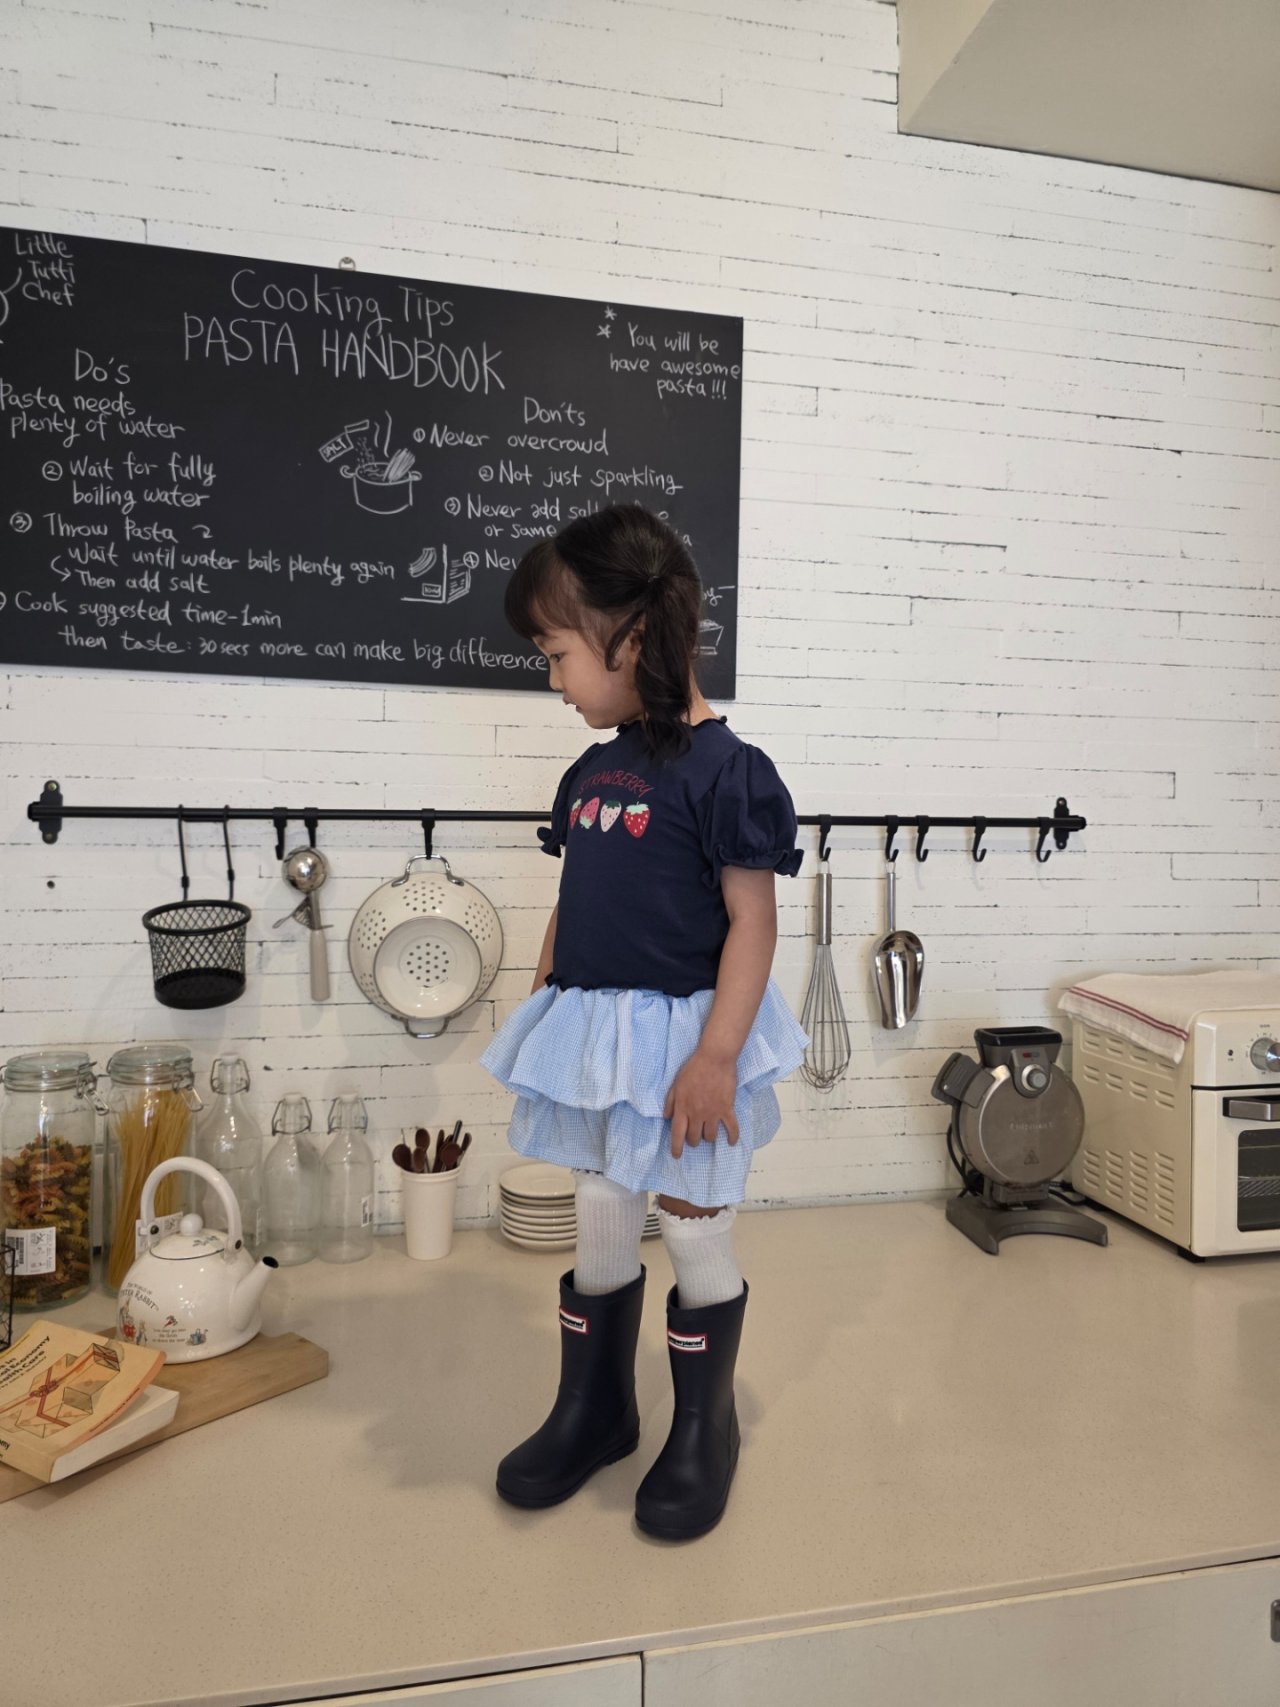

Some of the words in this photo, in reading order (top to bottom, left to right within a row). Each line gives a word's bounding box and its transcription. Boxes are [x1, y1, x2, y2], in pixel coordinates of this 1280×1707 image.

[15, 233, 74, 258] Little
[21, 280, 75, 307] Chef
[231, 269, 392, 339] Cooking
[398, 285, 454, 338] Tips
[184, 312, 299, 375] PASTA
[322, 329, 505, 394] HANDBOOK
[628, 322, 657, 351] You
[664, 331, 690, 352] will
[699, 333, 719, 355] be
[75, 348, 131, 385] Do's
[610, 353, 650, 372] have
[660, 358, 741, 380] awesome
[0, 378, 66, 413] Pasta
[73, 391, 136, 419] needs
[523, 396, 586, 427] Don'ts
[11, 411, 81, 448] plenty
[85, 414, 107, 441] of
[119, 416, 187, 439] water
[430, 423, 490, 448] Never
[507, 428, 609, 456] overcrowd
[69, 455, 114, 481] Wait
[122, 451, 159, 480] for
[168, 451, 217, 487] fully
[499, 459, 533, 486] Not
[542, 465, 582, 488] just
[591, 465, 684, 496] sparkling
[73, 480, 137, 515] boiling
[143, 484, 211, 507] water
[467, 493, 522, 519] Never
[531, 497, 560, 521] add
[42, 512, 108, 537] Throw
[124, 516, 179, 544] Pasta
[485, 524, 504, 537] or
[511, 523, 558, 539] same
[67, 541, 119, 567] Wait
[132, 546, 175, 570] until
[181, 549, 240, 570] water
[247, 548, 282, 574] boils
[288, 553, 345, 586] plenty
[350, 561, 396, 584] again
[74, 568, 116, 589] Then
[125, 569, 161, 593] add
[169, 572, 211, 594] salt
[15, 590, 69, 614] Cook
[78, 598, 172, 627] suggested
[58, 625, 108, 650] then
[260, 642, 307, 657] more
[315, 642, 345, 660] can
[353, 640, 405, 662] make
[414, 639, 445, 669] big
[449, 637, 548, 671] difference
